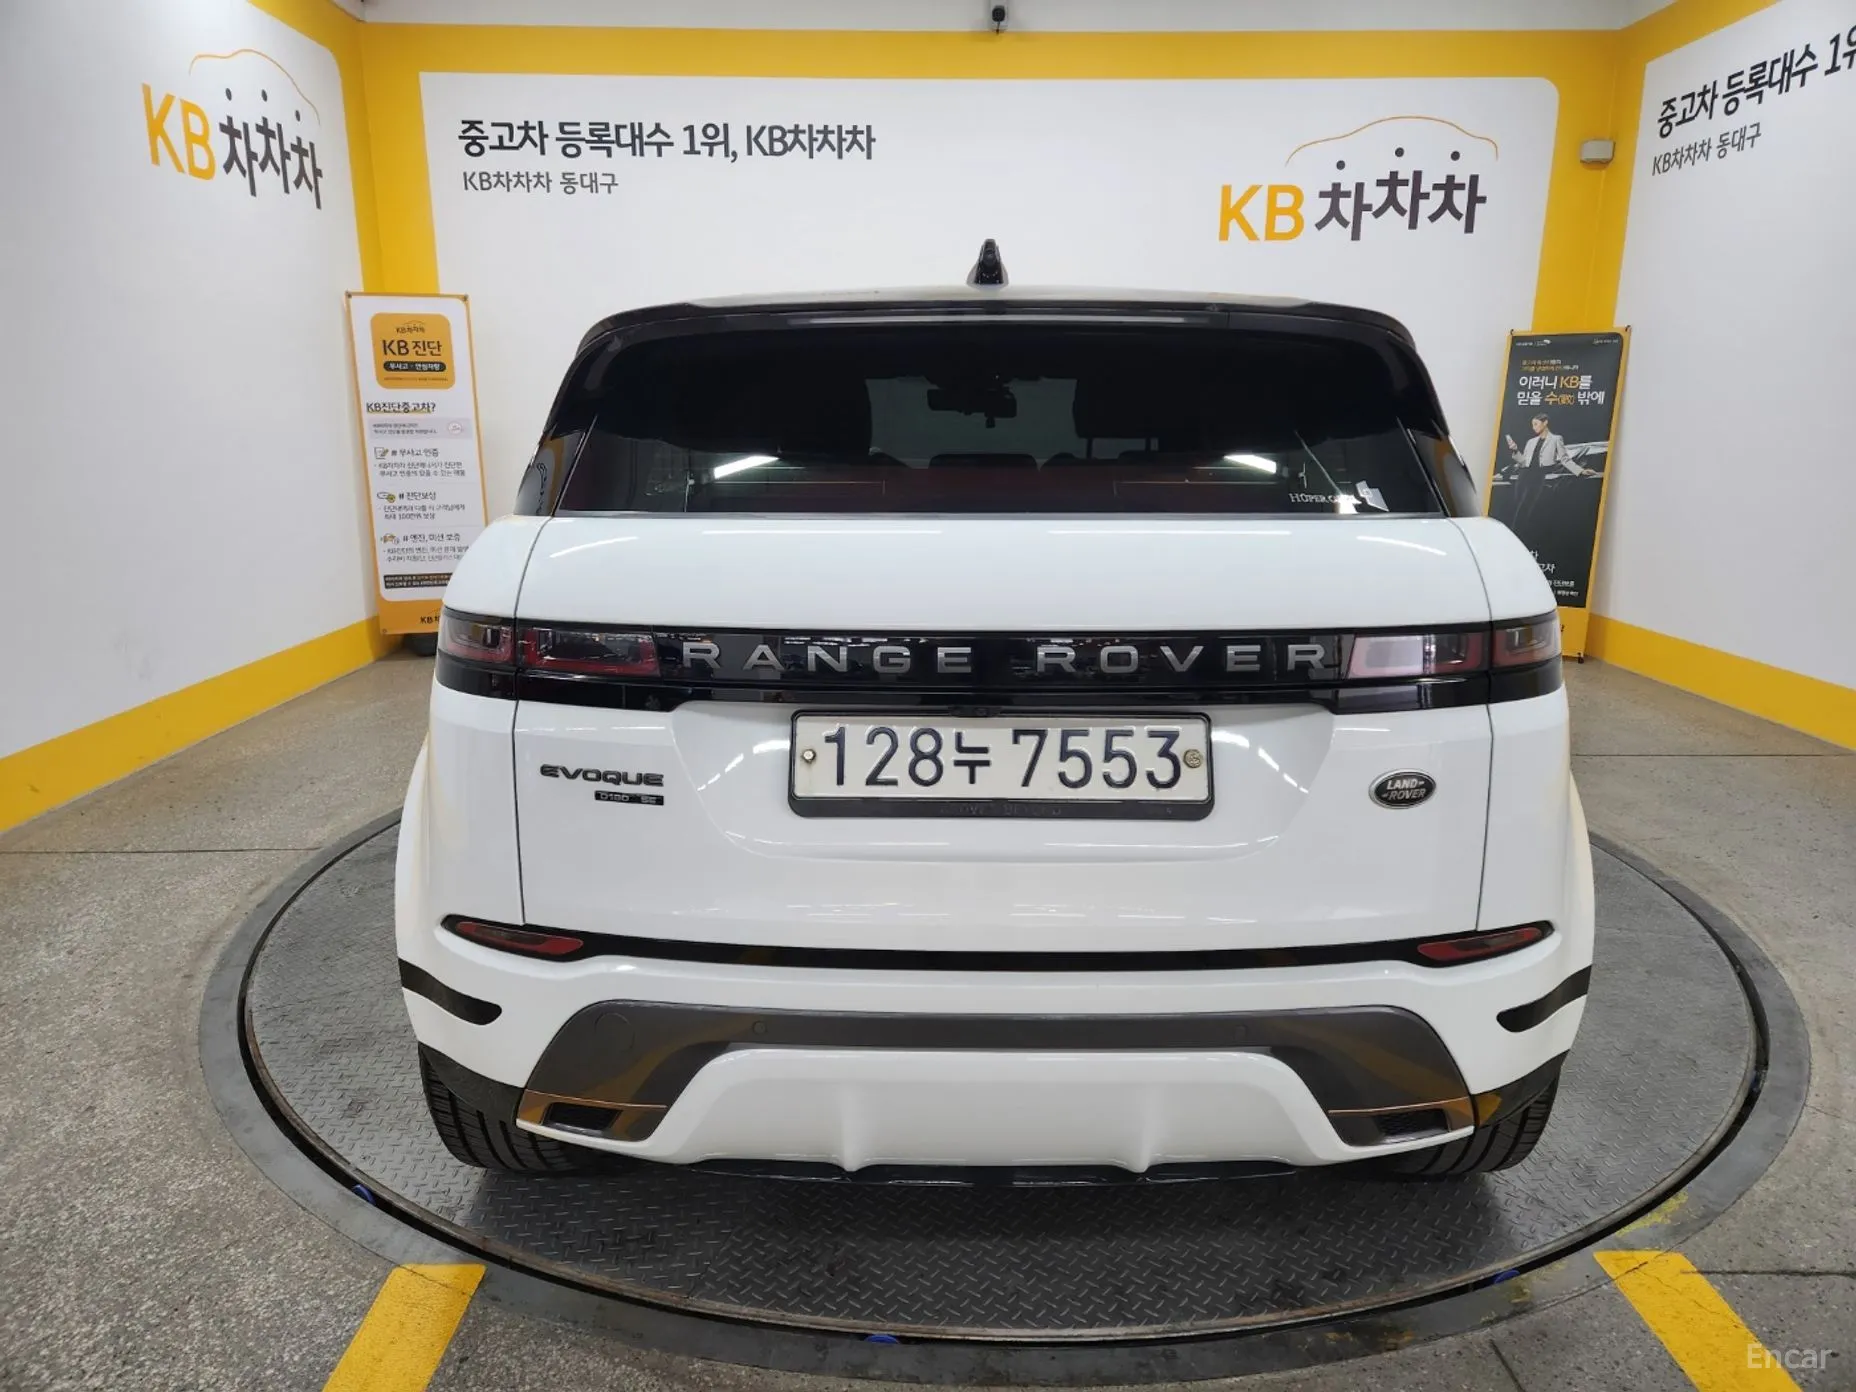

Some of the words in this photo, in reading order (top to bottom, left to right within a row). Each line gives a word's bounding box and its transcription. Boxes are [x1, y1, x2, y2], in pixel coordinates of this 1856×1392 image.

[1656, 79, 1719, 139] 중고차
[1721, 43, 1819, 117] 등록대수
[141, 82, 217, 181] KB
[218, 87, 324, 210] 차차차
[457, 118, 549, 158] 중고차
[554, 120, 675, 158] 등록대수
[681, 121, 739, 163] 1위,
[745, 123, 877, 160] KB차차차
[1651, 136, 1713, 177] KB차차차
[1716, 121, 1762, 160] 동대구
[462, 170, 553, 193] KB차차차
[559, 170, 619, 195] 동대구
[1218, 183, 1305, 242] KB
[1314, 146, 1488, 242] 차차차
[382, 339, 410, 356] KB
[412, 340, 443, 357] 진단
[1518, 374, 1558, 390] 이러니
[1559, 374, 1593, 390] KB를
[366, 401, 436, 414] KB진단중고차?
[1516, 390, 1542, 406] 믿을
[1577, 390, 1606, 406] 밖에
[681, 640, 974, 676] RANGE
[1035, 641, 1326, 676] ROVER
[823, 725, 993, 788] 128누
[1011, 727, 1182, 790] 7553
[540, 763, 665, 787] EVOQUE
[1388, 788, 1427, 801] ROVER
